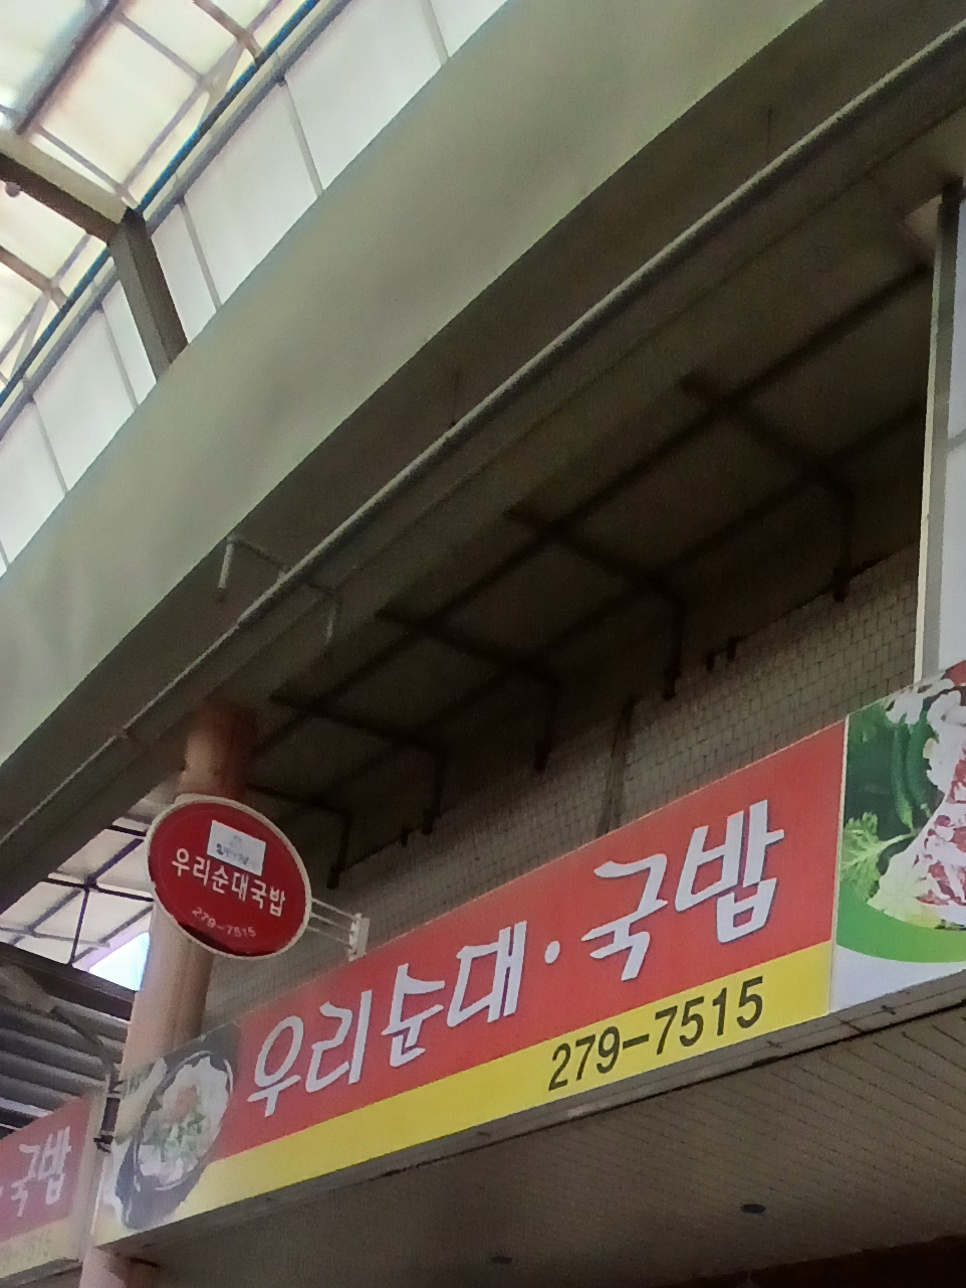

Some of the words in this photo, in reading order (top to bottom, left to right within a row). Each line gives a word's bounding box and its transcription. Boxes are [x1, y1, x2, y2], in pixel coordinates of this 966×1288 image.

[171, 847, 287, 918] 우리순대국밥
[191, 906, 258, 939] 279-7515
[547, 975, 765, 1092] 279-7515
